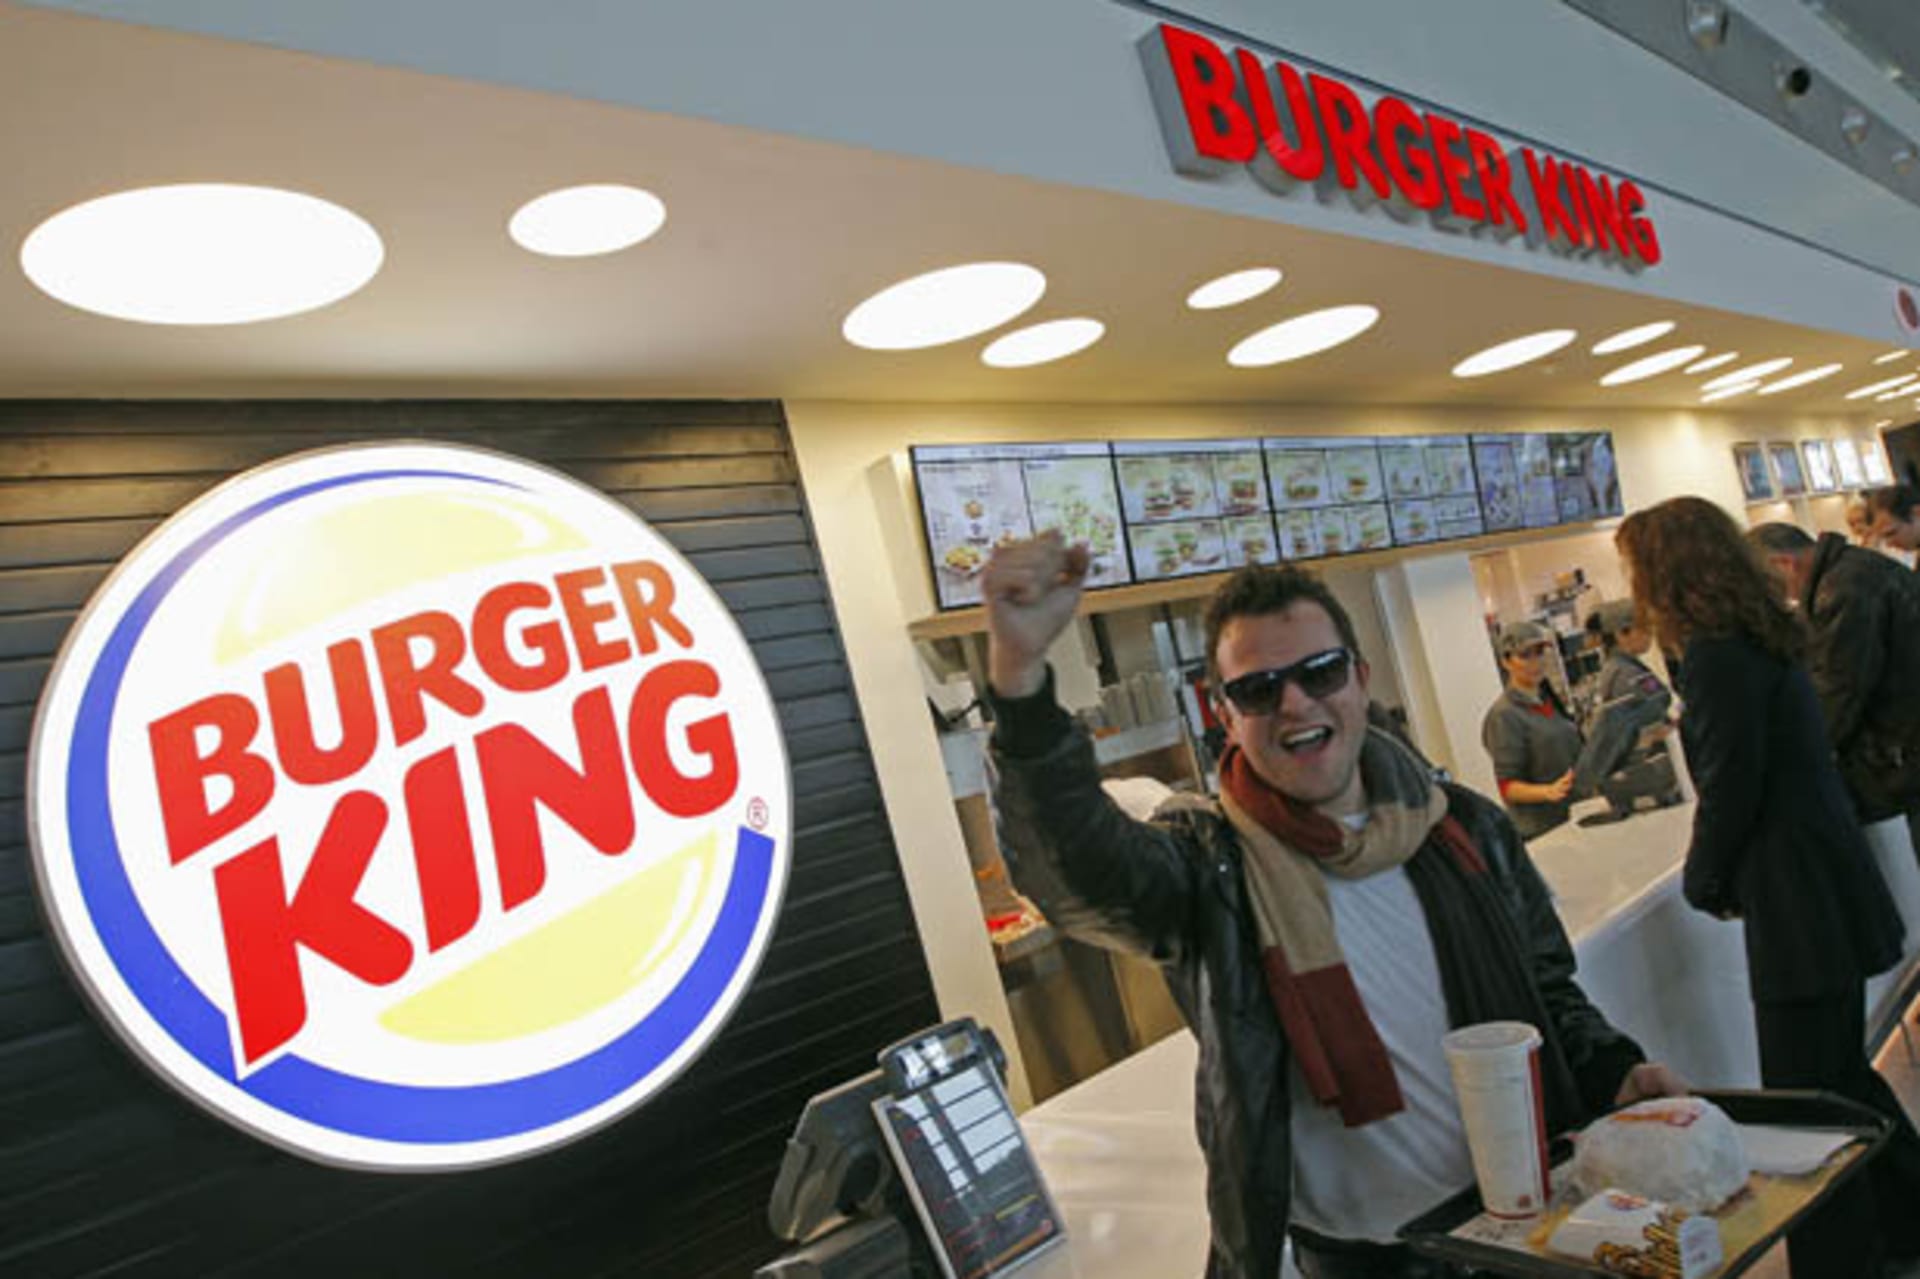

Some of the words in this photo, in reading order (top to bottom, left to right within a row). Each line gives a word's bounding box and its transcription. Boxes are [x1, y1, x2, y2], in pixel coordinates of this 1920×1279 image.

[1161, 24, 1527, 235] BURGER
[1523, 148, 1660, 265] KING
[148, 560, 694, 867] BURGER
[213, 660, 740, 1066] KING
